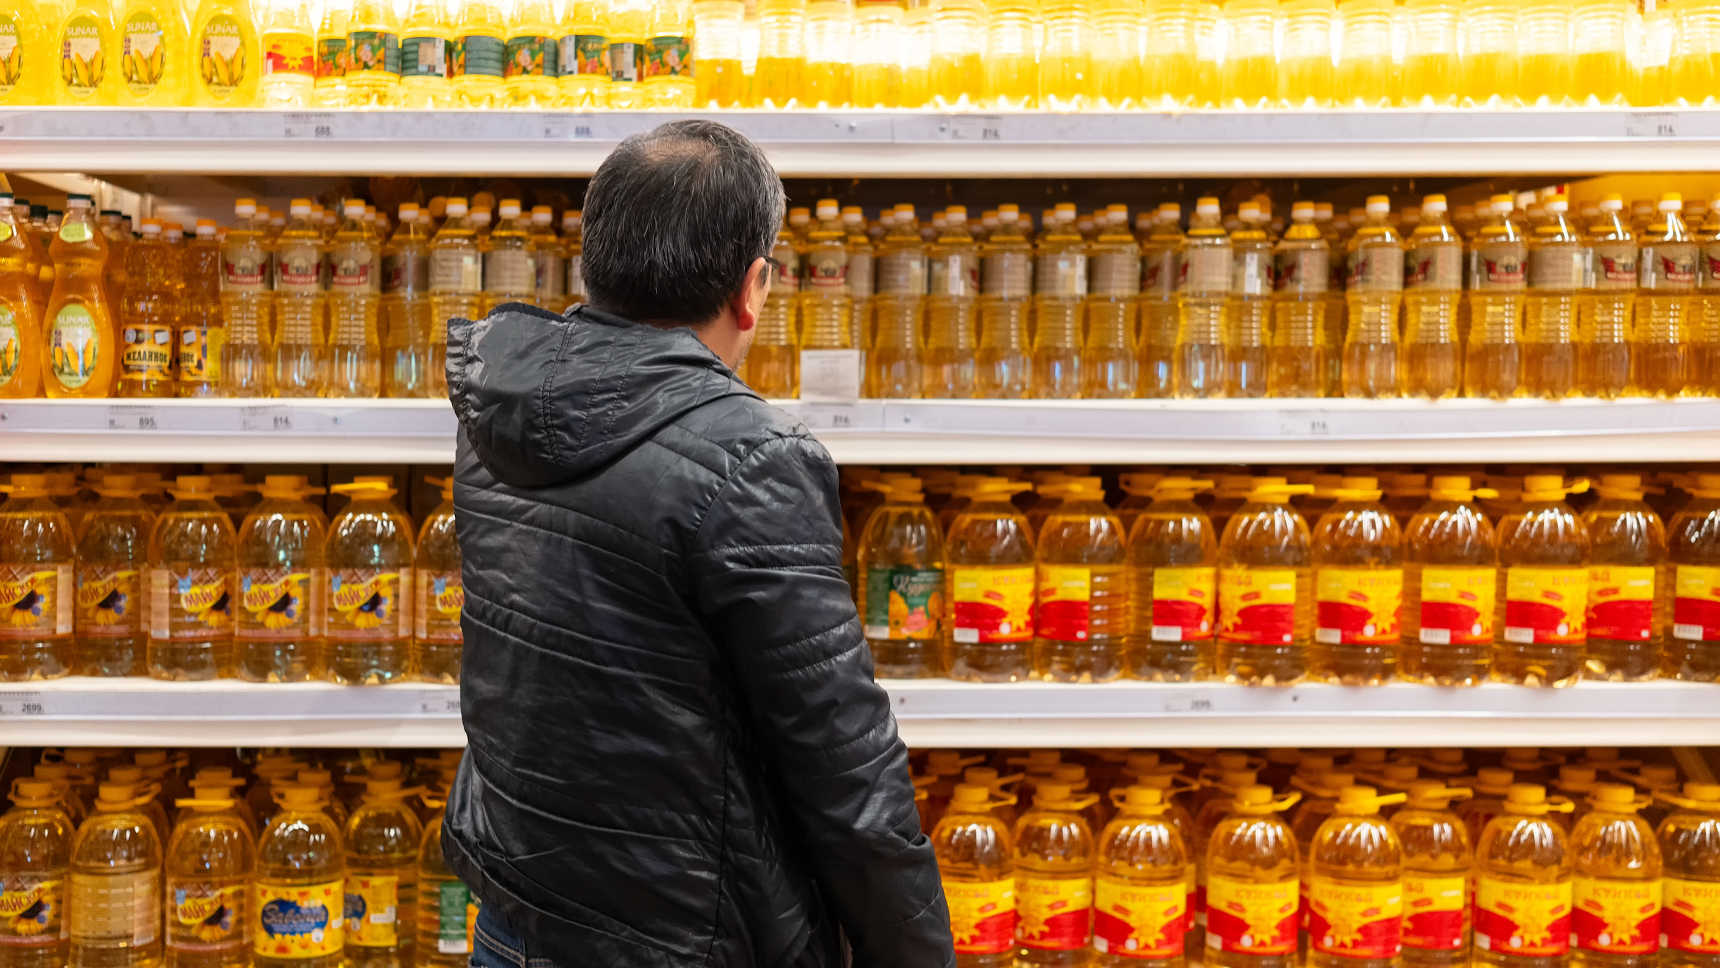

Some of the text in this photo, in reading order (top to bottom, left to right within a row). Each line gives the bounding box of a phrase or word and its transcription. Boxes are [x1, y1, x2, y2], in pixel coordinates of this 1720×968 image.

[67, 26, 98, 36] SUNAR
[126, 21, 158, 32] SUNAR
[205, 24, 239, 34] SUNAR
[57, 315, 90, 325] SUNAR
[126, 351, 168, 363] ЖЕЛАННОЕ
